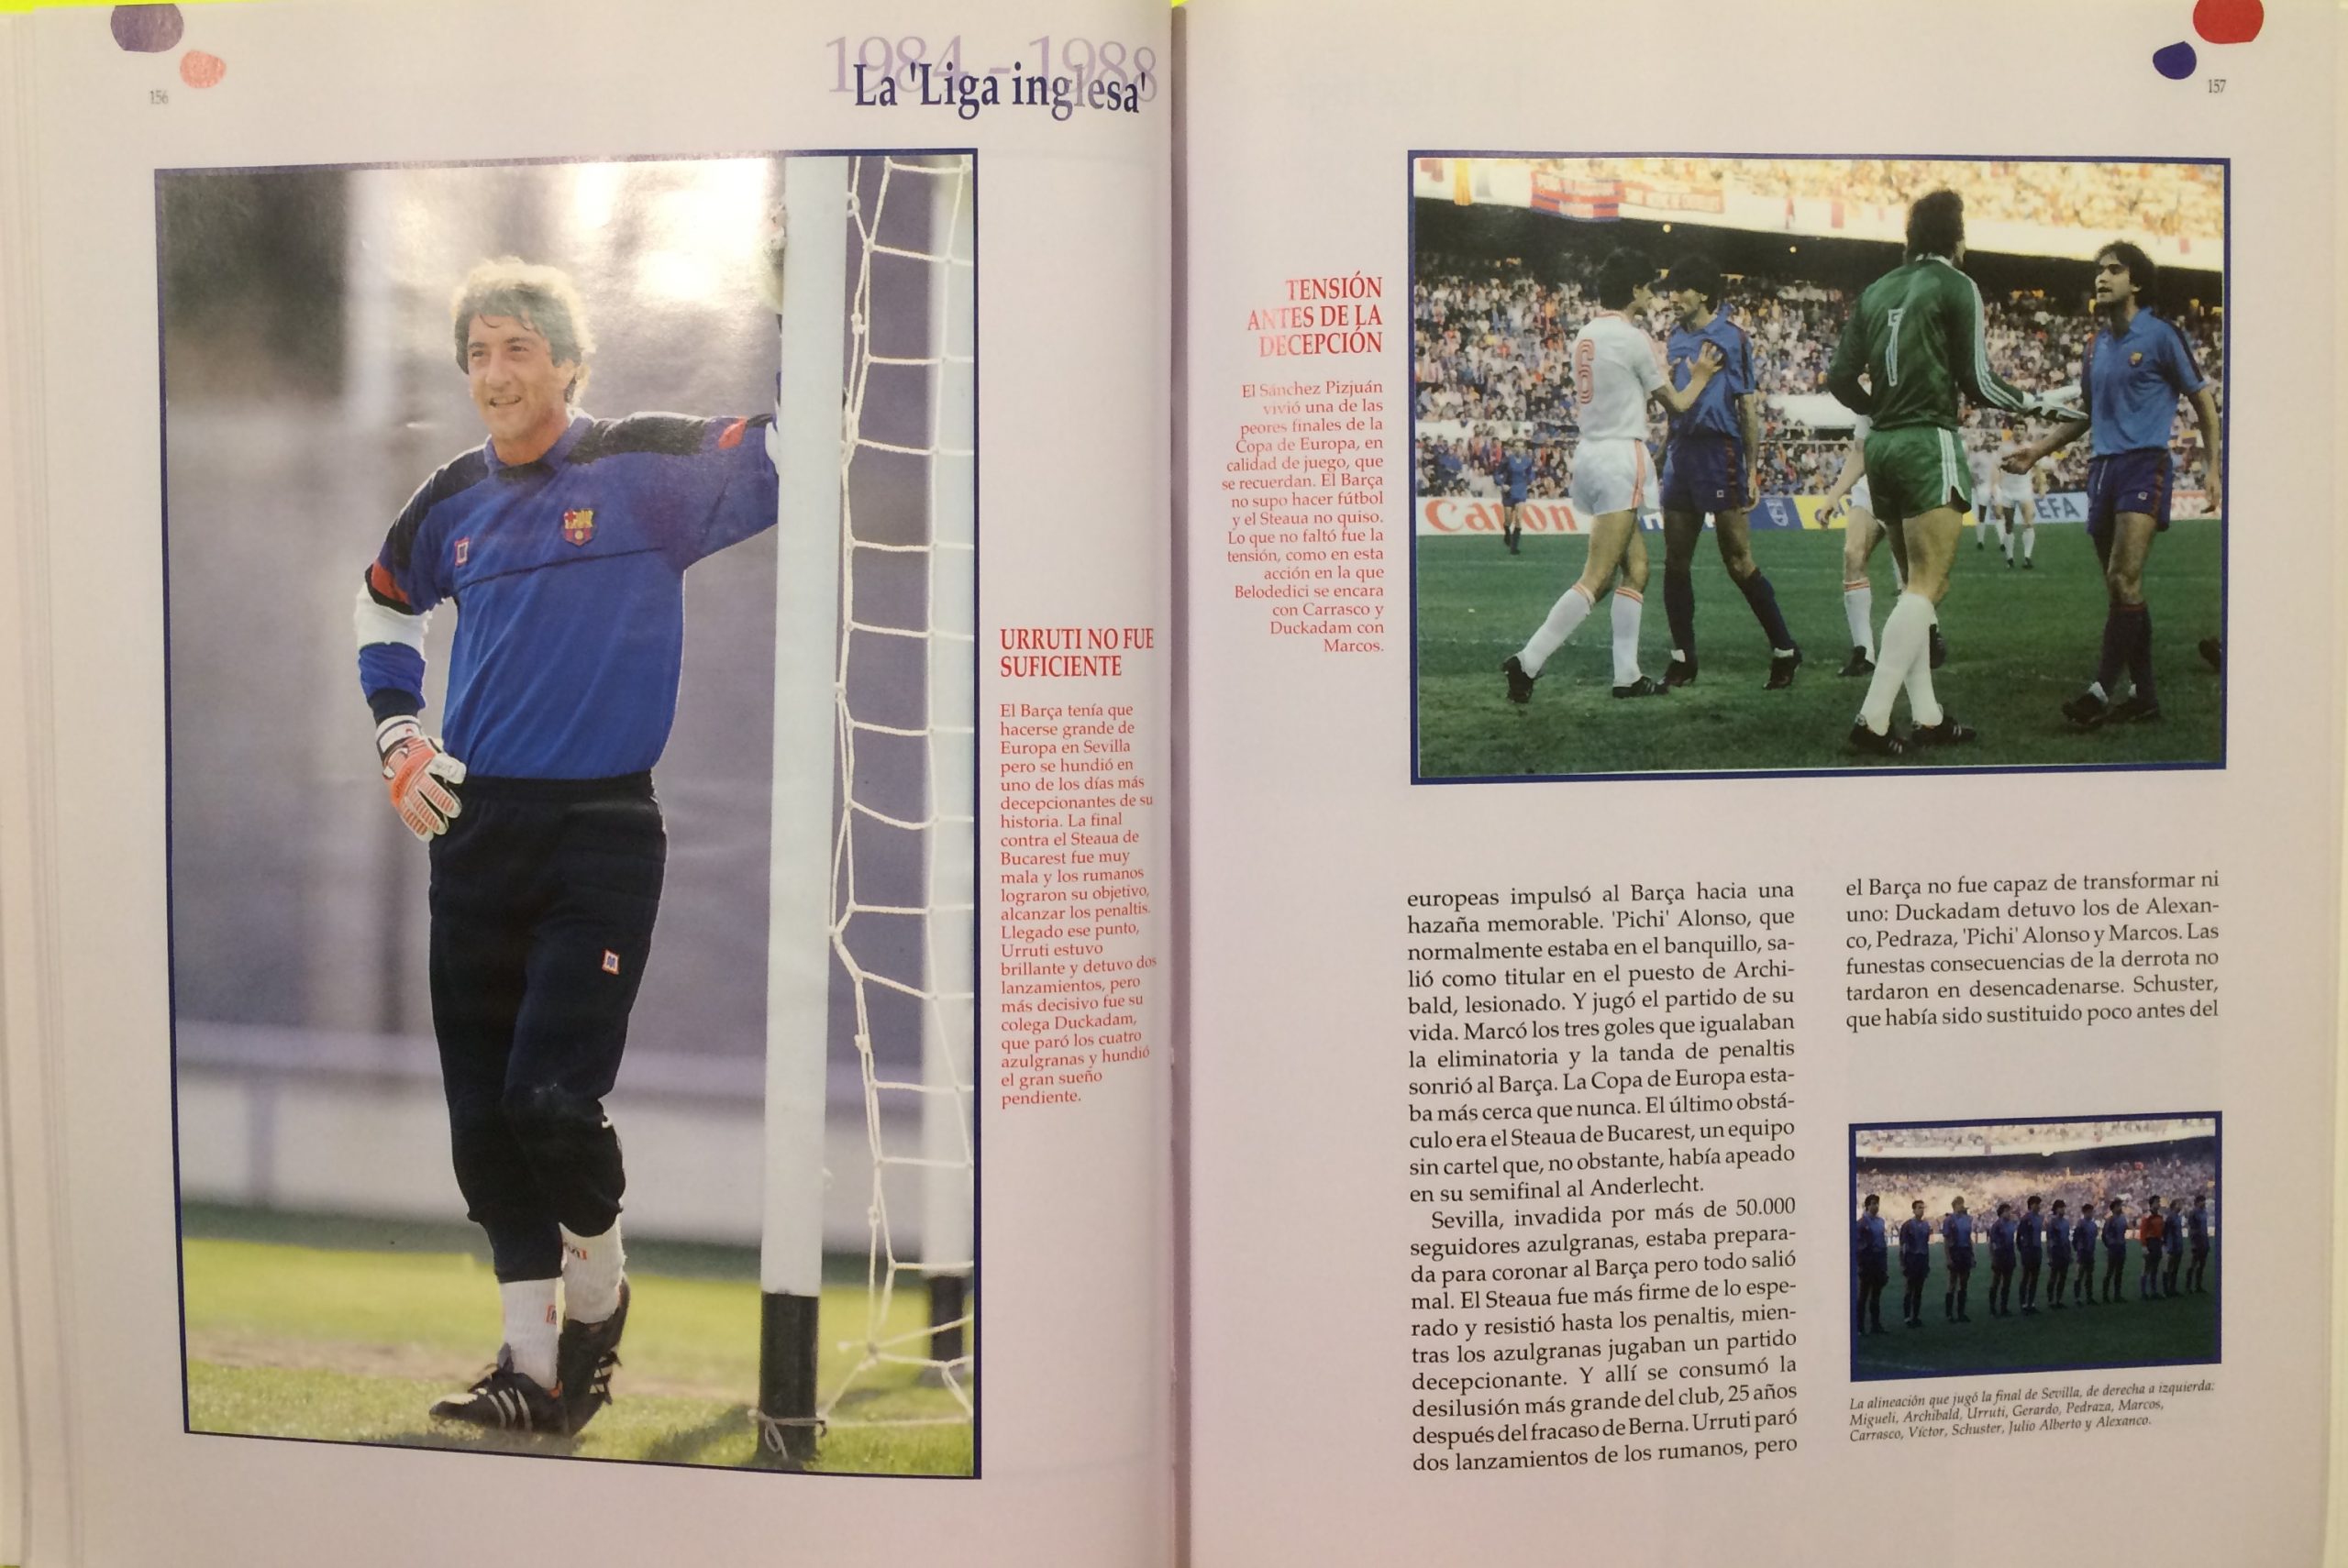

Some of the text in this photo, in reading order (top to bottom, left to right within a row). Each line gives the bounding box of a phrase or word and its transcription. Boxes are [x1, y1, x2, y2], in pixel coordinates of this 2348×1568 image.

[826, 35, 969, 93] 1984
[1028, 35, 1157, 104] 1988
[150, 90, 169, 105] 156
[853, 61, 1147, 122] La 'Liga inglesa'
[2208, 79, 2227, 94] 157
[1285, 271, 1382, 301] TENSIÓN
[1246, 304, 1383, 331] ANTES DE LA
[1259, 326, 1382, 358] DECEPCIÓN
[1575, 338, 1595, 404] 6
[1242, 383, 1256, 399] El
[1325, 380, 1383, 397] Pizjuán
[1235, 436, 1383, 458] Copa de Europa, en
[1231, 491, 1383, 512] no supo hacer fútbol
[2018, 496, 2081, 519] EFA
[1227, 547, 1384, 563] tensión, como en esta
[1235, 584, 1384, 599] Belodedici se encara
[1000, 627, 1155, 650] URRUTI NO FUE
[1270, 620, 1384, 635] Duckadam con
[1324, 638, 1384, 653] Marcos.
[1001, 655, 1122, 678] SUFICIENTE
[1001, 703, 1134, 722] El Barça tenía que
[1001, 738, 1131, 759] Europa en Sevilla
[1001, 775, 1146, 791] uno de los días más
[1001, 829, 1140, 847] contra el Steaua de
[1846, 869, 2220, 900] el Barça no fue capaz de transformar ni
[1407, 881, 1794, 912] europeas impulsó al Barça hacia una
[1846, 896, 2220, 922] uno: Duckadam detuvo los de Alexan-
[1002, 922, 1140, 943] Llegado ese punto,
[1846, 949, 2219, 975] funestas consecuencias de la derrota no
[1001, 1012, 1137, 1035] colega Duckadam,
[1845, 999, 2219, 1033] que había sido sustituido poco antes del
[1409, 1039, 1795, 1070] la eliminatoria y la tanda de penaltis
[1001, 1070, 1103, 1090] el gran sueño
[1002, 1090, 1081, 1110] pendiente.
[1432, 1197, 1796, 1231] Sevilla, invadida por más de 50.000
[1412, 1329, 1797, 1366] tras los azulgranas jugaban un partido
[1412, 1384, 1798, 1418] desilusión más grande del club, 25 años
[1849, 1397, 1865, 1410] La
[1866, 1395, 1925, 1409] alineación
[1929, 1396, 1950, 1409] que
[1951, 1391, 1978, 1408] jugó
[1981, 1390, 1992, 1403] la
[1993, 1388, 2022, 1406] final
[2024, 1387, 2039, 1400] de
[2086, 1384, 2099, 1397] de
[2101, 1382, 2145, 1397] derecha
[2148, 1385, 2155, 1395] a
[2008, 1419, 2036, 1435] Julio
[2039, 1418, 2082, 1431] Alberto
[2084, 1419, 2092, 1432] y
